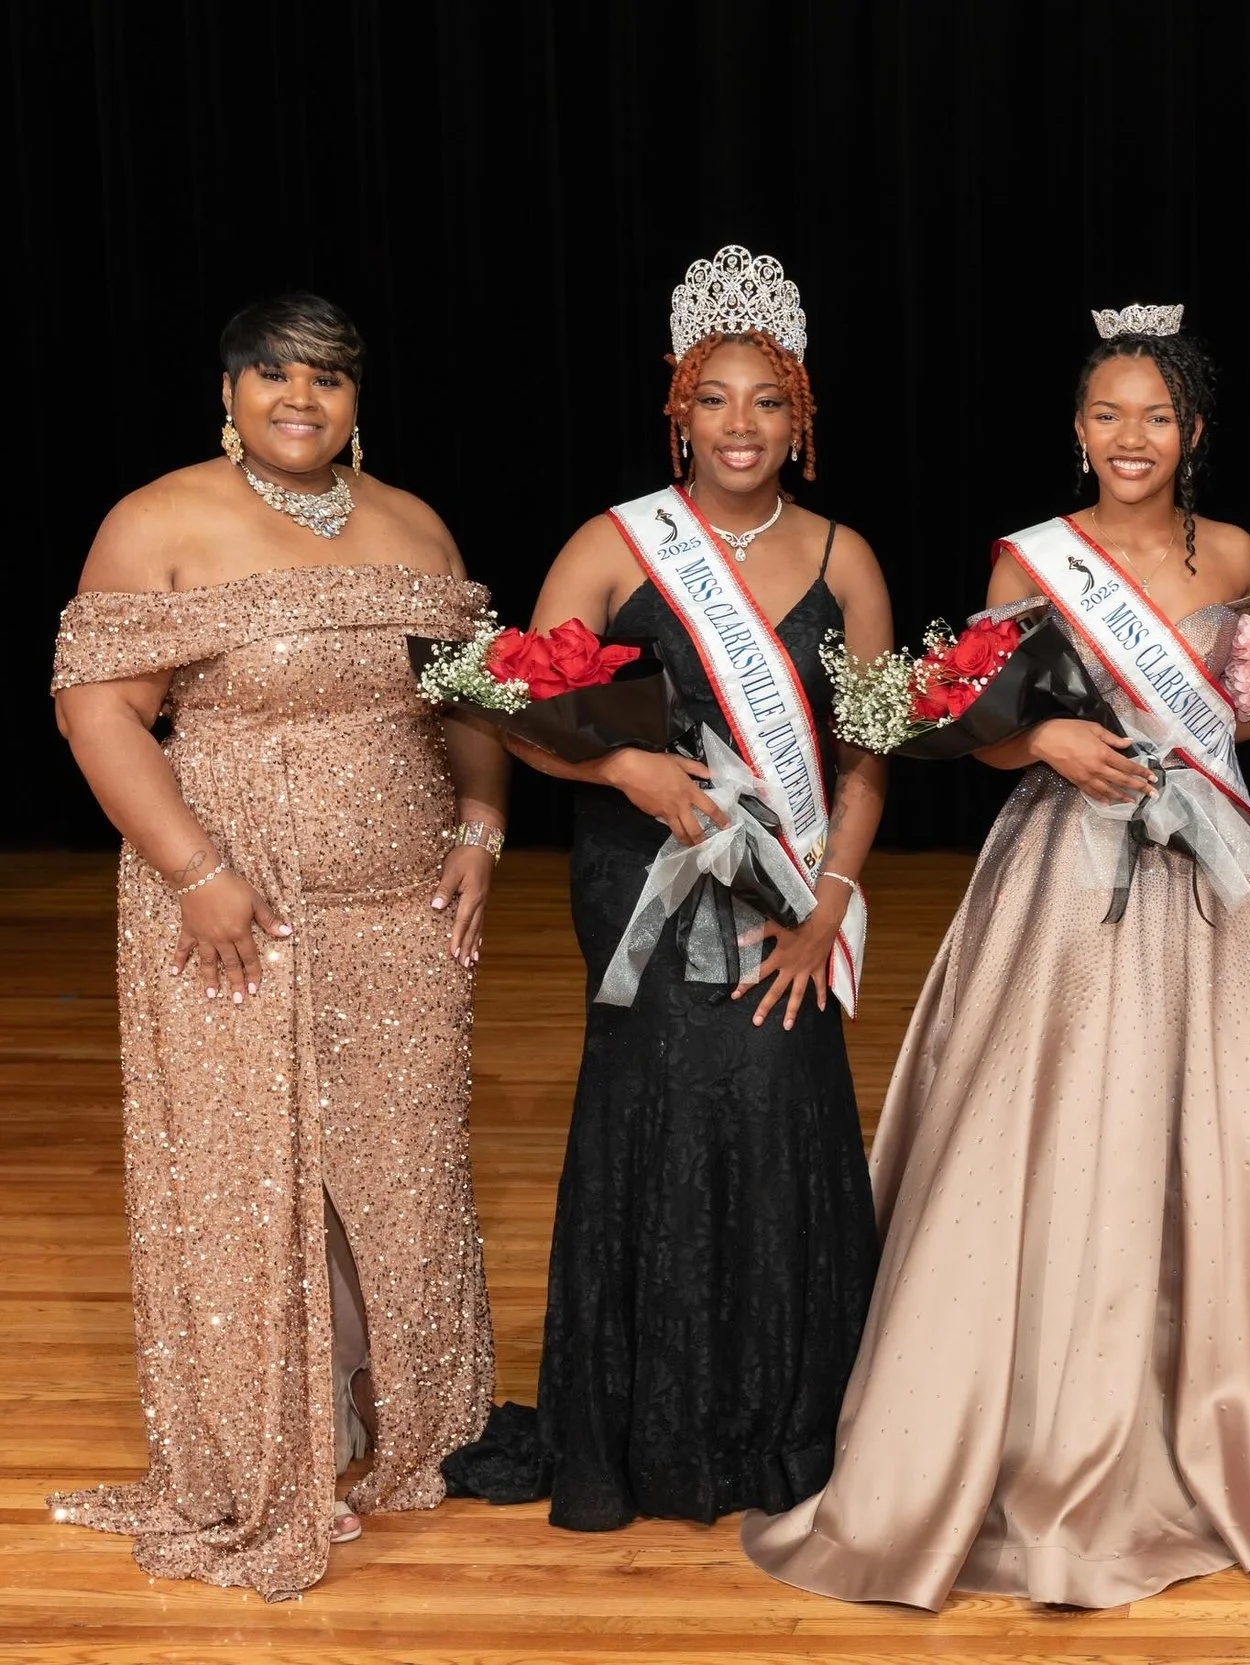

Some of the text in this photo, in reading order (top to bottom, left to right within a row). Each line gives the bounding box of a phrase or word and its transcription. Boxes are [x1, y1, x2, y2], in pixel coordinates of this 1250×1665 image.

[657, 536, 701, 561] 2025
[1079, 579, 1120, 612] 2025
[675, 556, 817, 838] MISS CLARKSVILLE JUNETEENTH
[1101, 602, 1225, 747] MISS CLARKSVILLE
